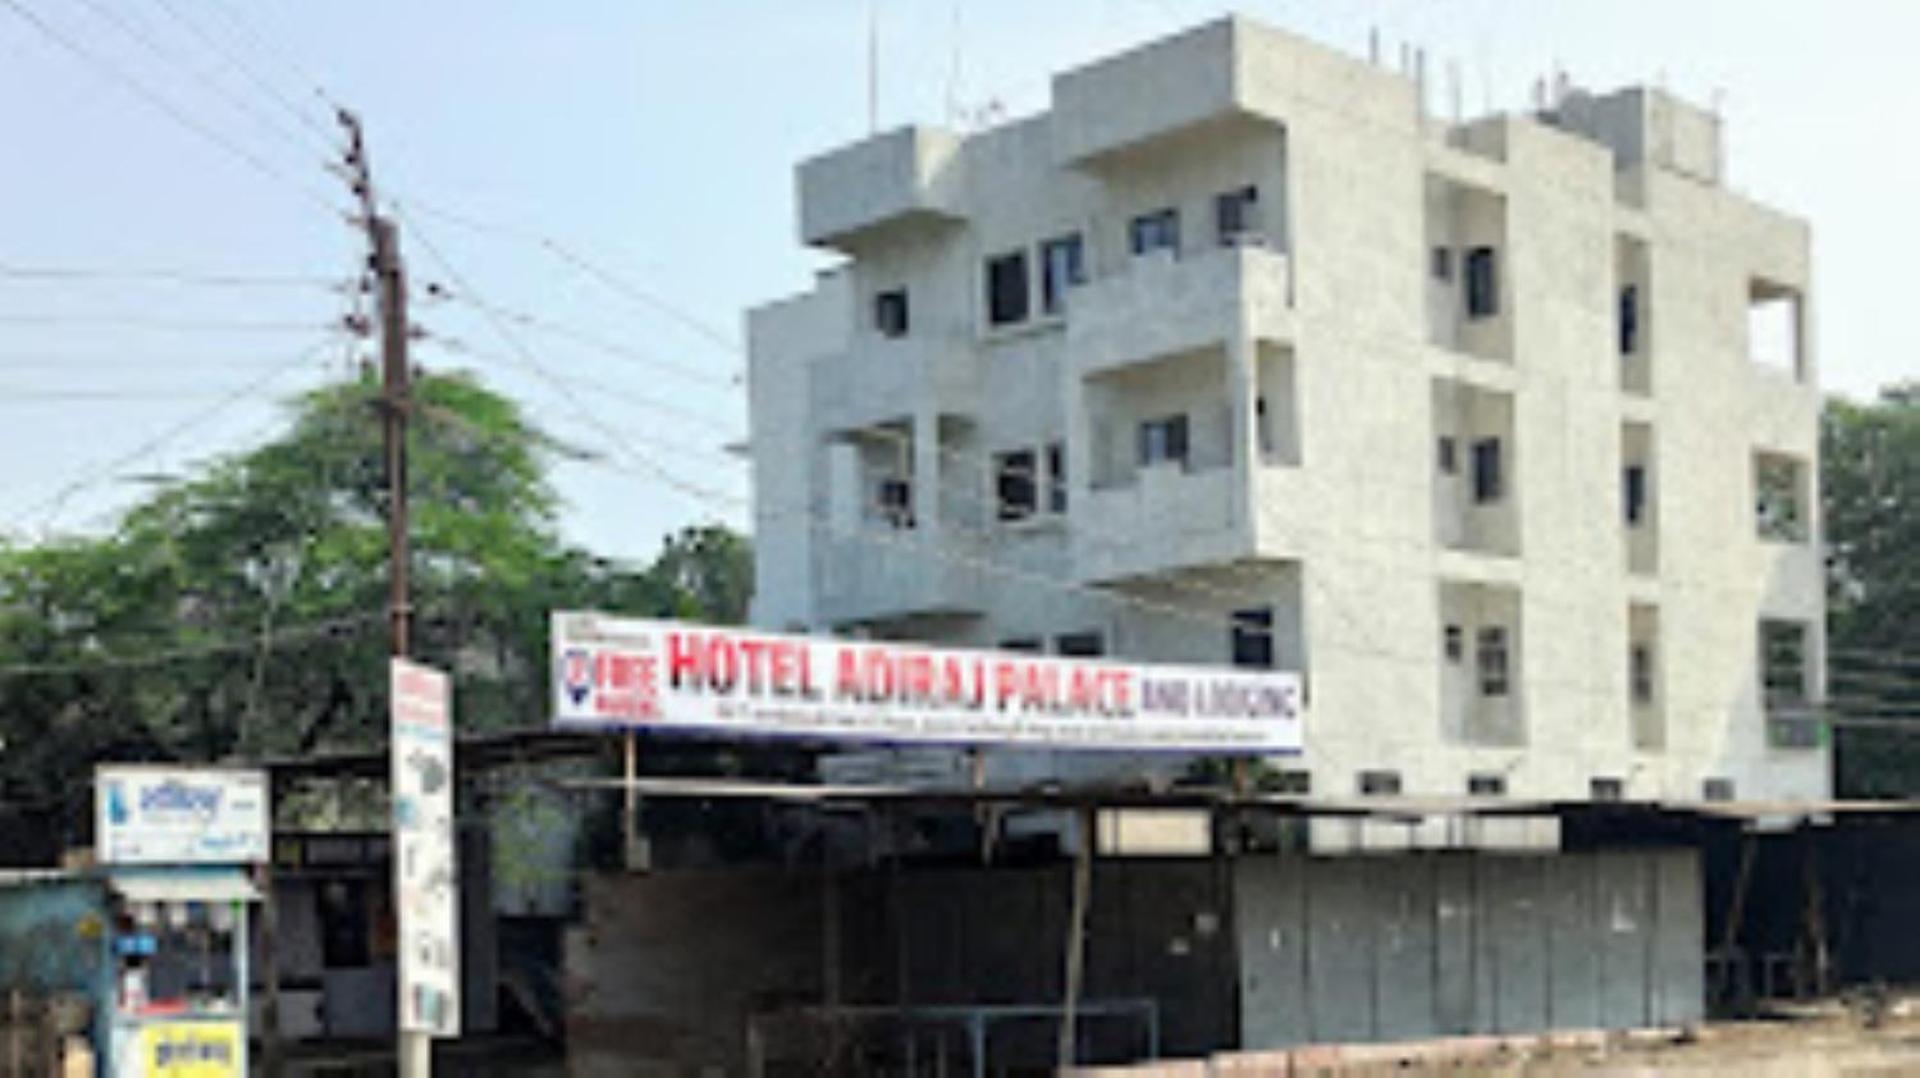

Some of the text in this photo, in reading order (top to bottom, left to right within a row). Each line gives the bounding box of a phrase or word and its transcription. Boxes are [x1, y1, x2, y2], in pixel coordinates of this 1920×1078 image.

[667, 632, 822, 698] HOTEL
[834, 648, 985, 710] ADIRAJ
[993, 663, 1136, 717] PALACE
